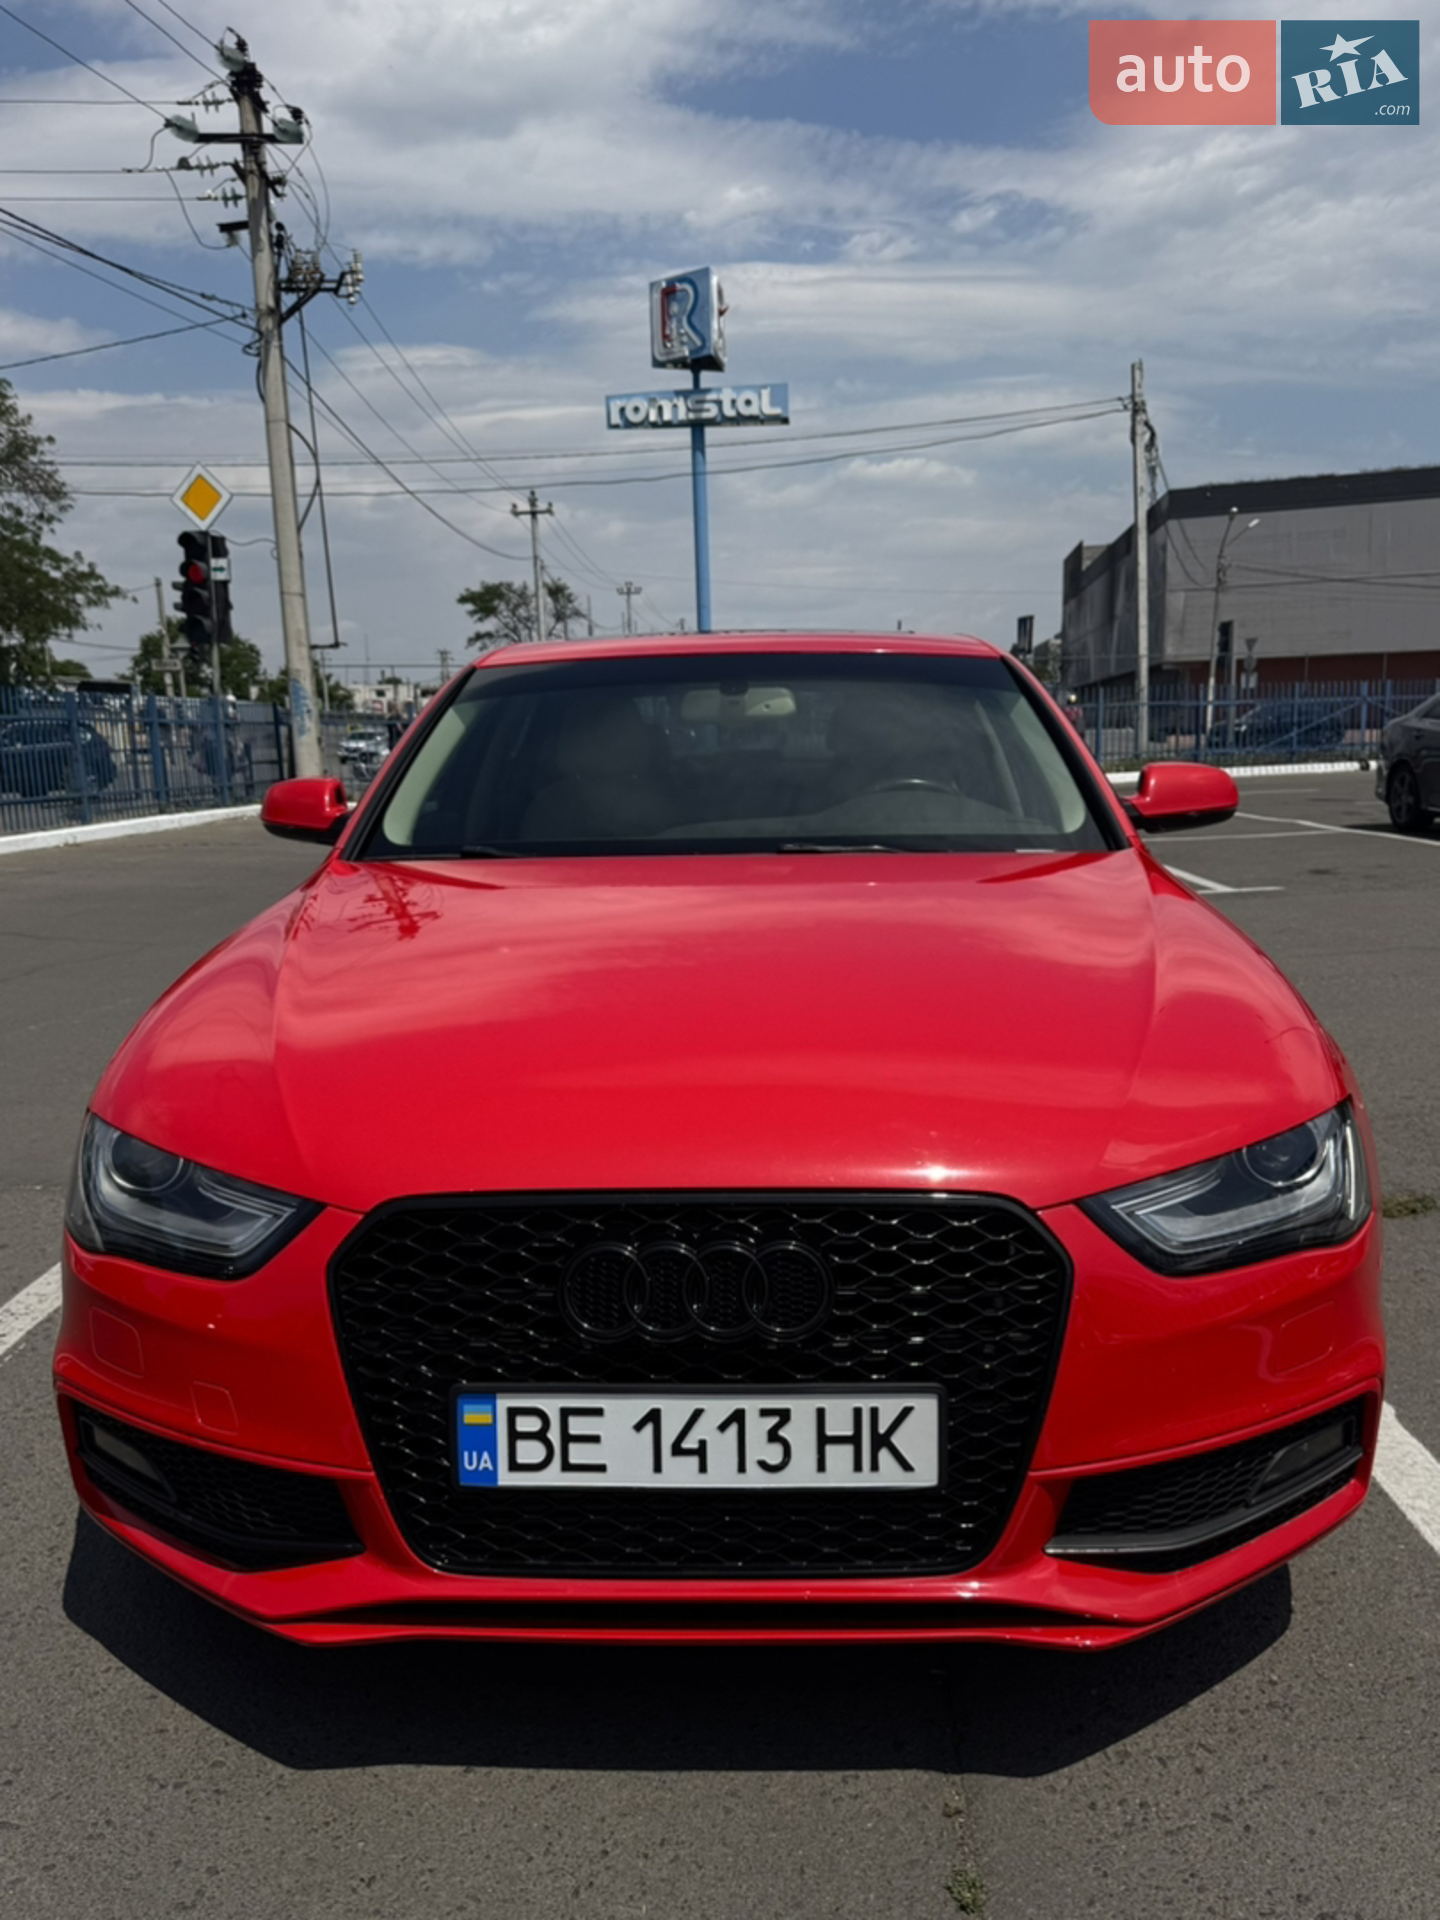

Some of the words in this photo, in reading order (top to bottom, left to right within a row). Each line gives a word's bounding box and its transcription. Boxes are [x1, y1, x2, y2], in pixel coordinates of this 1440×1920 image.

[463, 1450, 494, 1472] UA
[506, 1406, 607, 1473] BE
[632, 1407, 792, 1474] 1413
[816, 1406, 915, 1473] HK
